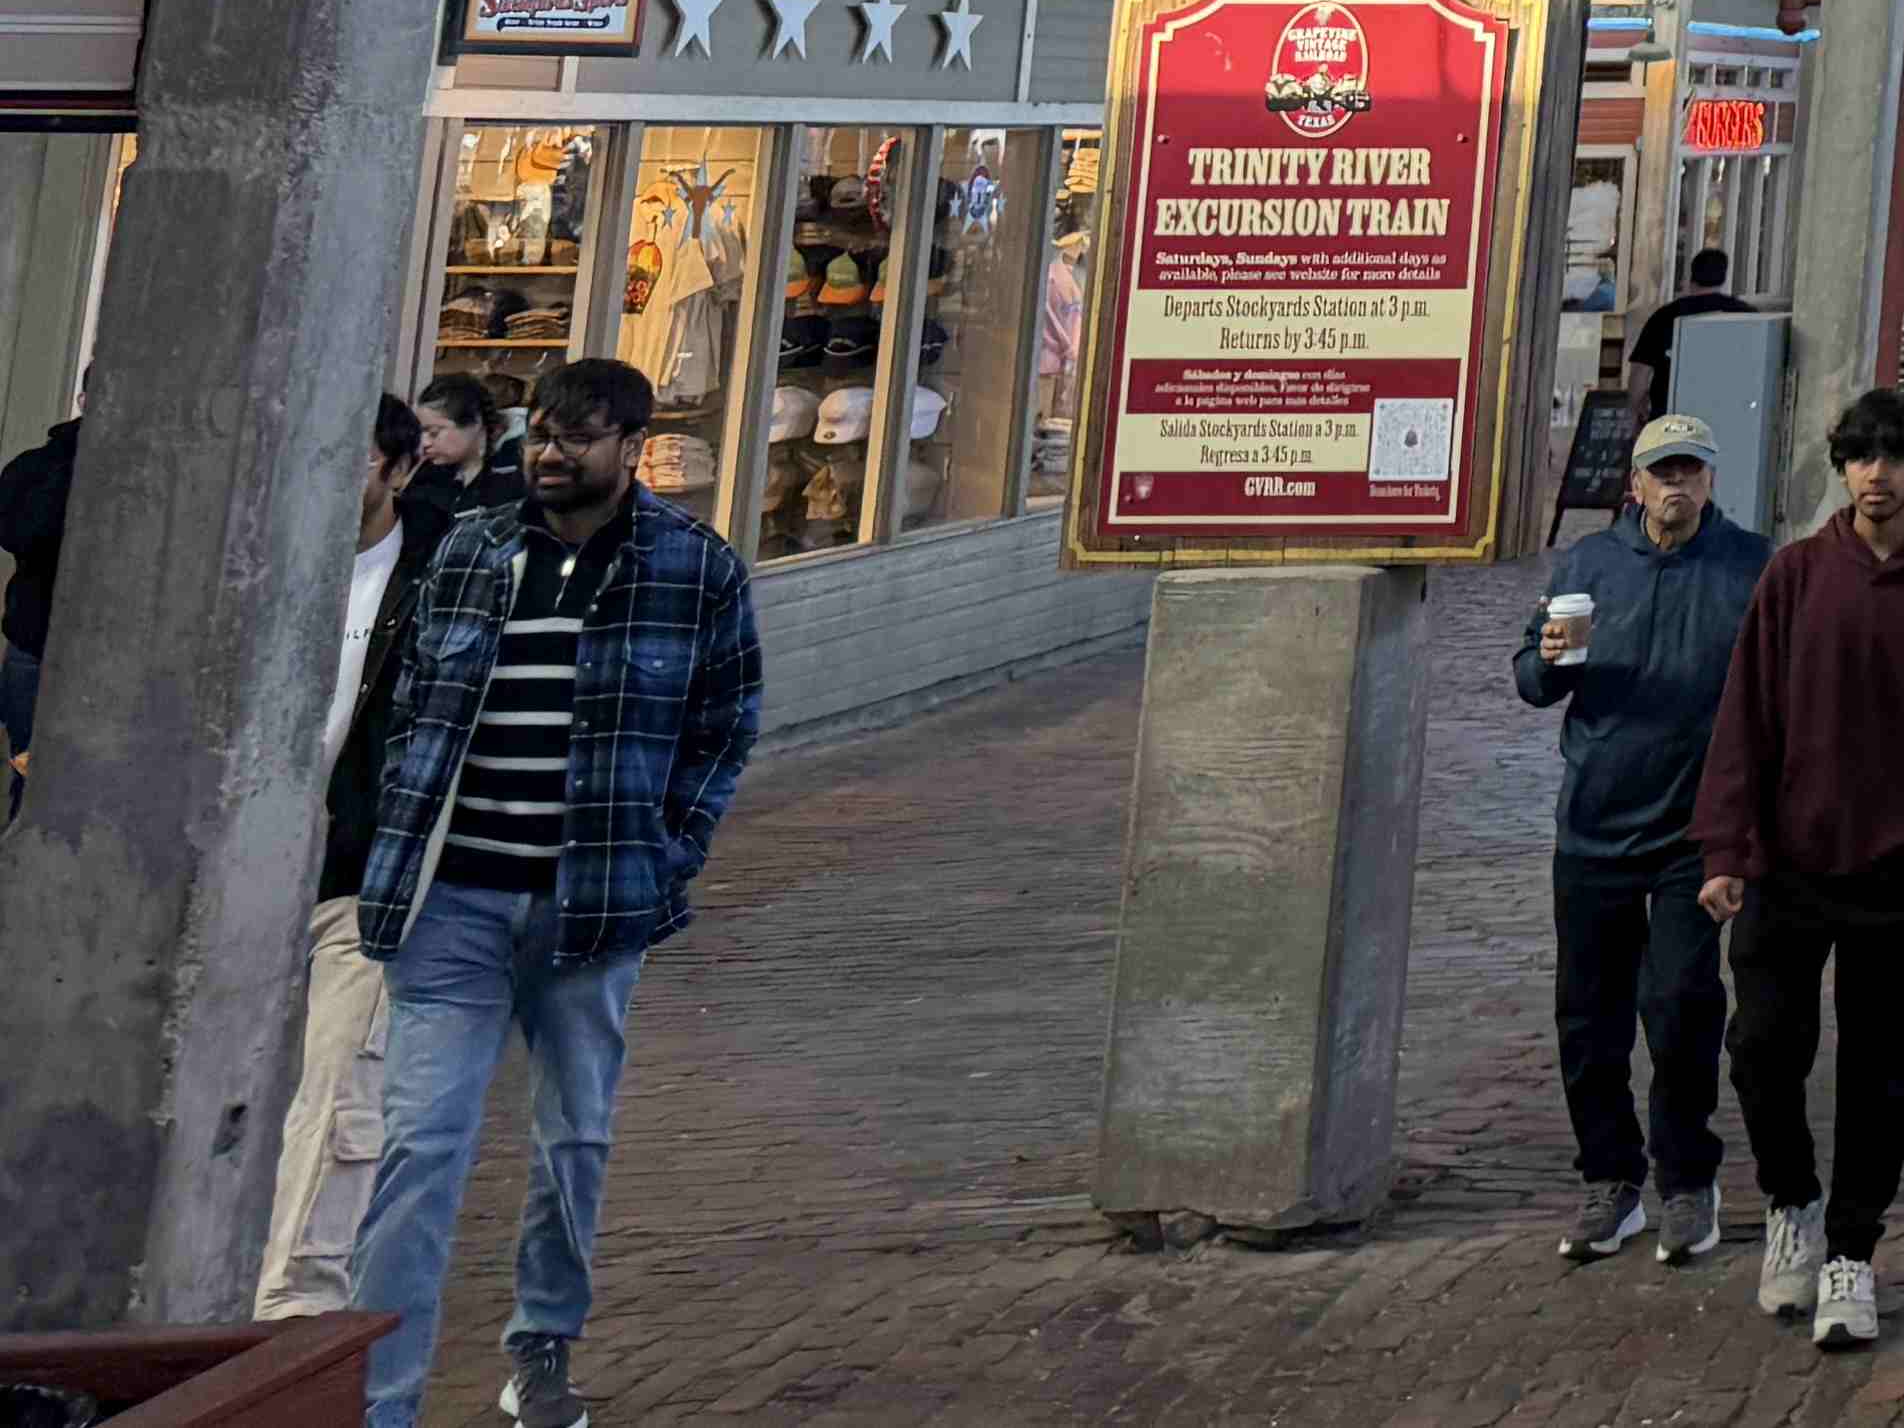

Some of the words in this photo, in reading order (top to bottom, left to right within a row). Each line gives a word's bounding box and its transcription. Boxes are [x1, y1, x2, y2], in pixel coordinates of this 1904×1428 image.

[1188, 147, 1329, 186] TRINITY
[1330, 147, 1431, 186] RIVER
[1153, 198, 1343, 237] EXCURSION
[1347, 198, 1450, 237] TRAIN
[1155, 251, 1233, 268] Saturdays,
[1236, 251, 1298, 268] Sundays
[1301, 251, 1330, 265] with
[1332, 251, 1397, 265] additional
[1399, 251, 1430, 268] days
[1431, 254, 1447, 265] as
[1159, 267, 1218, 282] available,
[1221, 267, 1262, 284] please
[1290, 267, 1338, 281] website
[1341, 267, 1361, 281] for
[1363, 270, 1396, 281] more
[1398, 266, 1441, 281] details
[1164, 295, 1223, 321] Departs
[1225, 295, 1310, 321] Stockyards
[1312, 295, 1367, 318] Station
[1370, 298, 1384, 318] at
[1388, 295, 1398, 318] 3
[1401, 300, 1430, 322] p.m.
[1219, 327, 1281, 350] Returns
[1284, 327, 1301, 353] by
[1304, 327, 1336, 350] 3:45
[1340, 331, 1369, 353] p.m.
[1160, 419, 1197, 438] Salida
[1199, 418, 1267, 441] Stockyards
[1268, 419, 1313, 438] Station
[1315, 424, 1322, 438] a
[1325, 419, 1333, 438] 3
[1200, 444, 1249, 467] Regresa
[1252, 449, 1259, 464] a
[1244, 476, 1317, 497] GVRR.com
